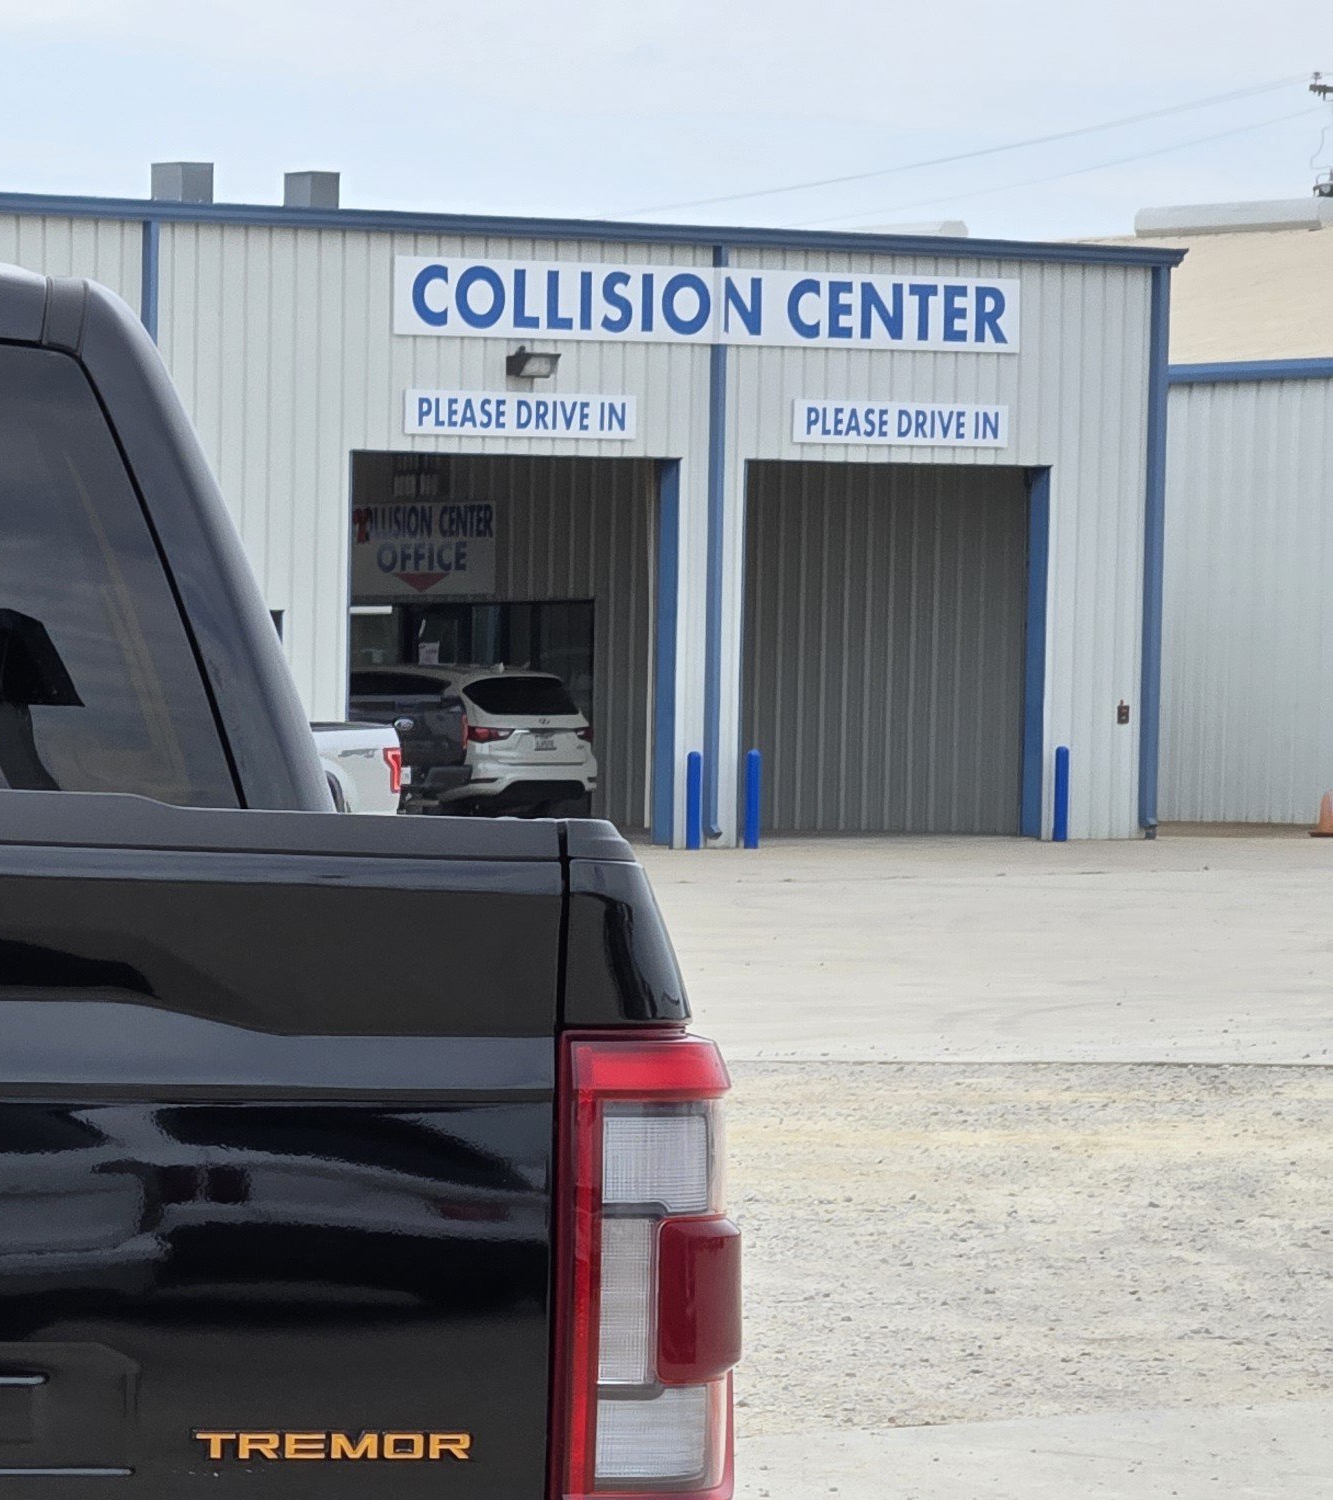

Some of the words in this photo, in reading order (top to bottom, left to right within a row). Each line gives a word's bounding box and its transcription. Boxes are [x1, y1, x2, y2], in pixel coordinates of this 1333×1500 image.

[412, 264, 762, 336] COLLISION
[787, 278, 1008, 344] CENTER
[417, 397, 506, 429] PLEASE
[516, 400, 590, 431] DRIVE
[599, 402, 626, 432] IN
[806, 406, 889, 438] PLEASE
[897, 409, 966, 440] DRIVE
[974, 411, 1000, 440] IN
[439, 504, 494, 538] CENTER
[376, 541, 468, 573] OFFICE
[195, 1432, 471, 1459] TREMOR
